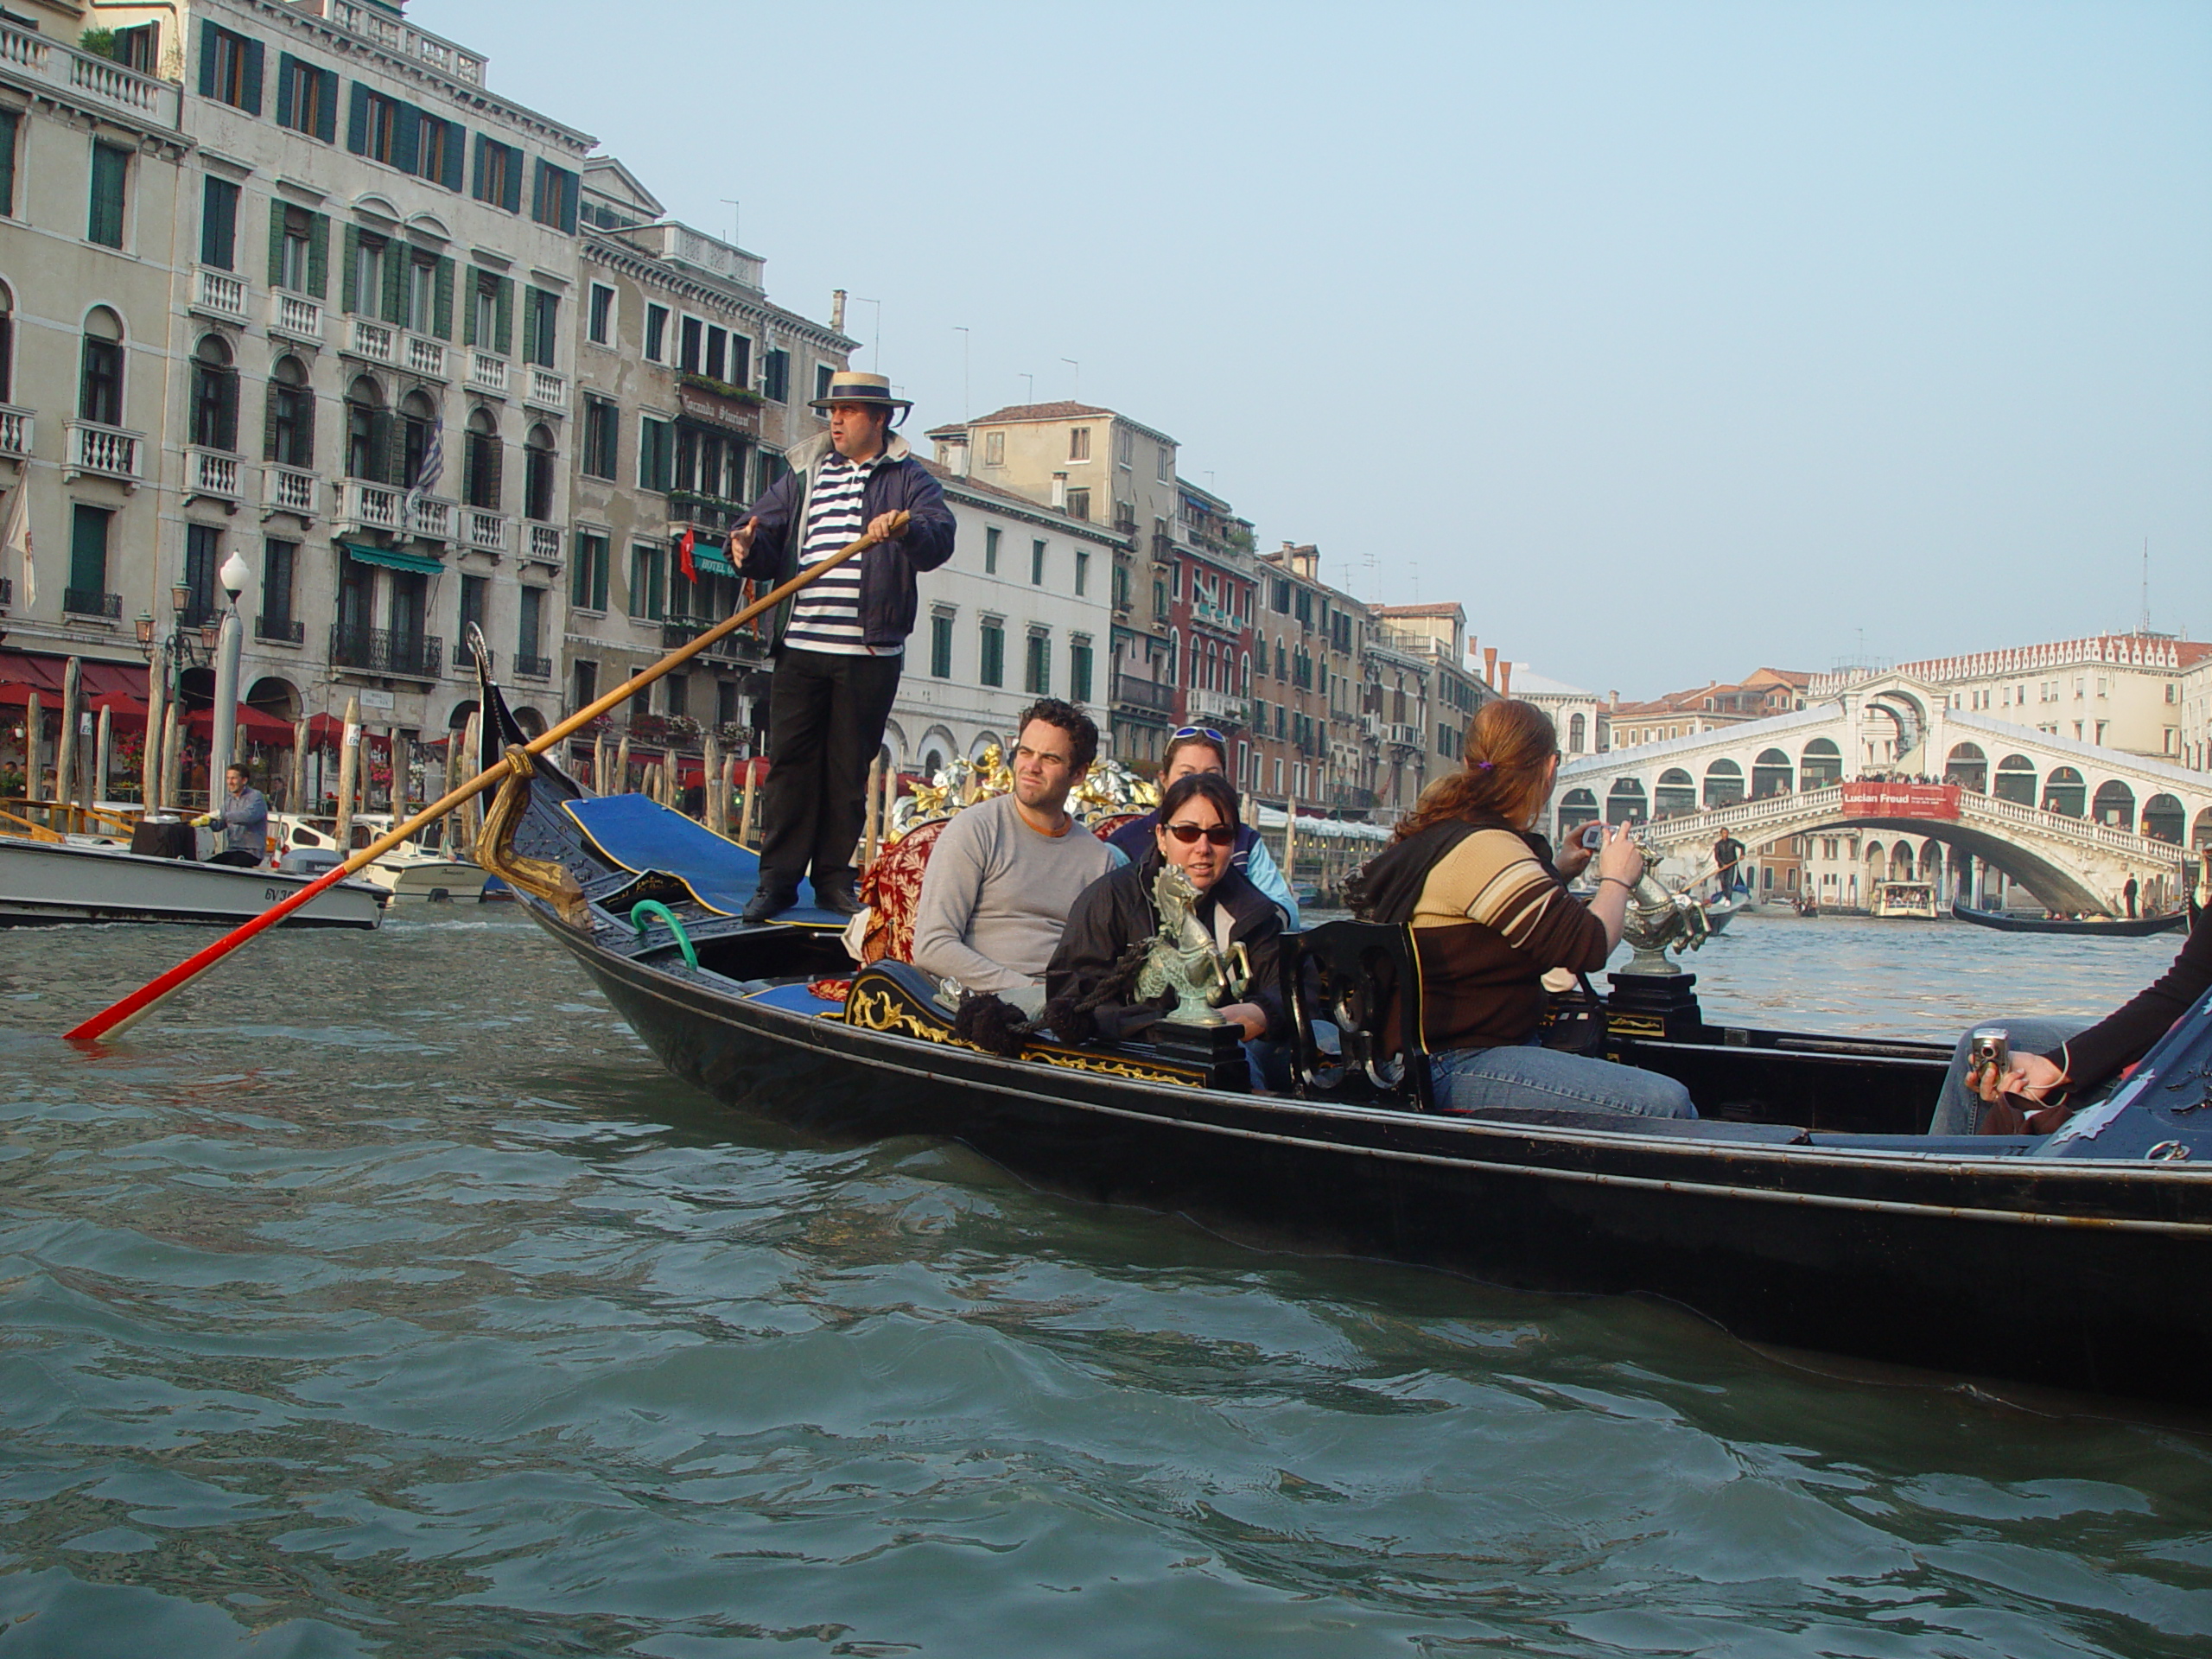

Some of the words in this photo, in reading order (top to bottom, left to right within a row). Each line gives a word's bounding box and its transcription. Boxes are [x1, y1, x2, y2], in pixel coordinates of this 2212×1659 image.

[702, 558, 725, 572] HOTEL
[1844, 793, 1878, 803] Lucian
[1880, 794, 1909, 804] Freud
